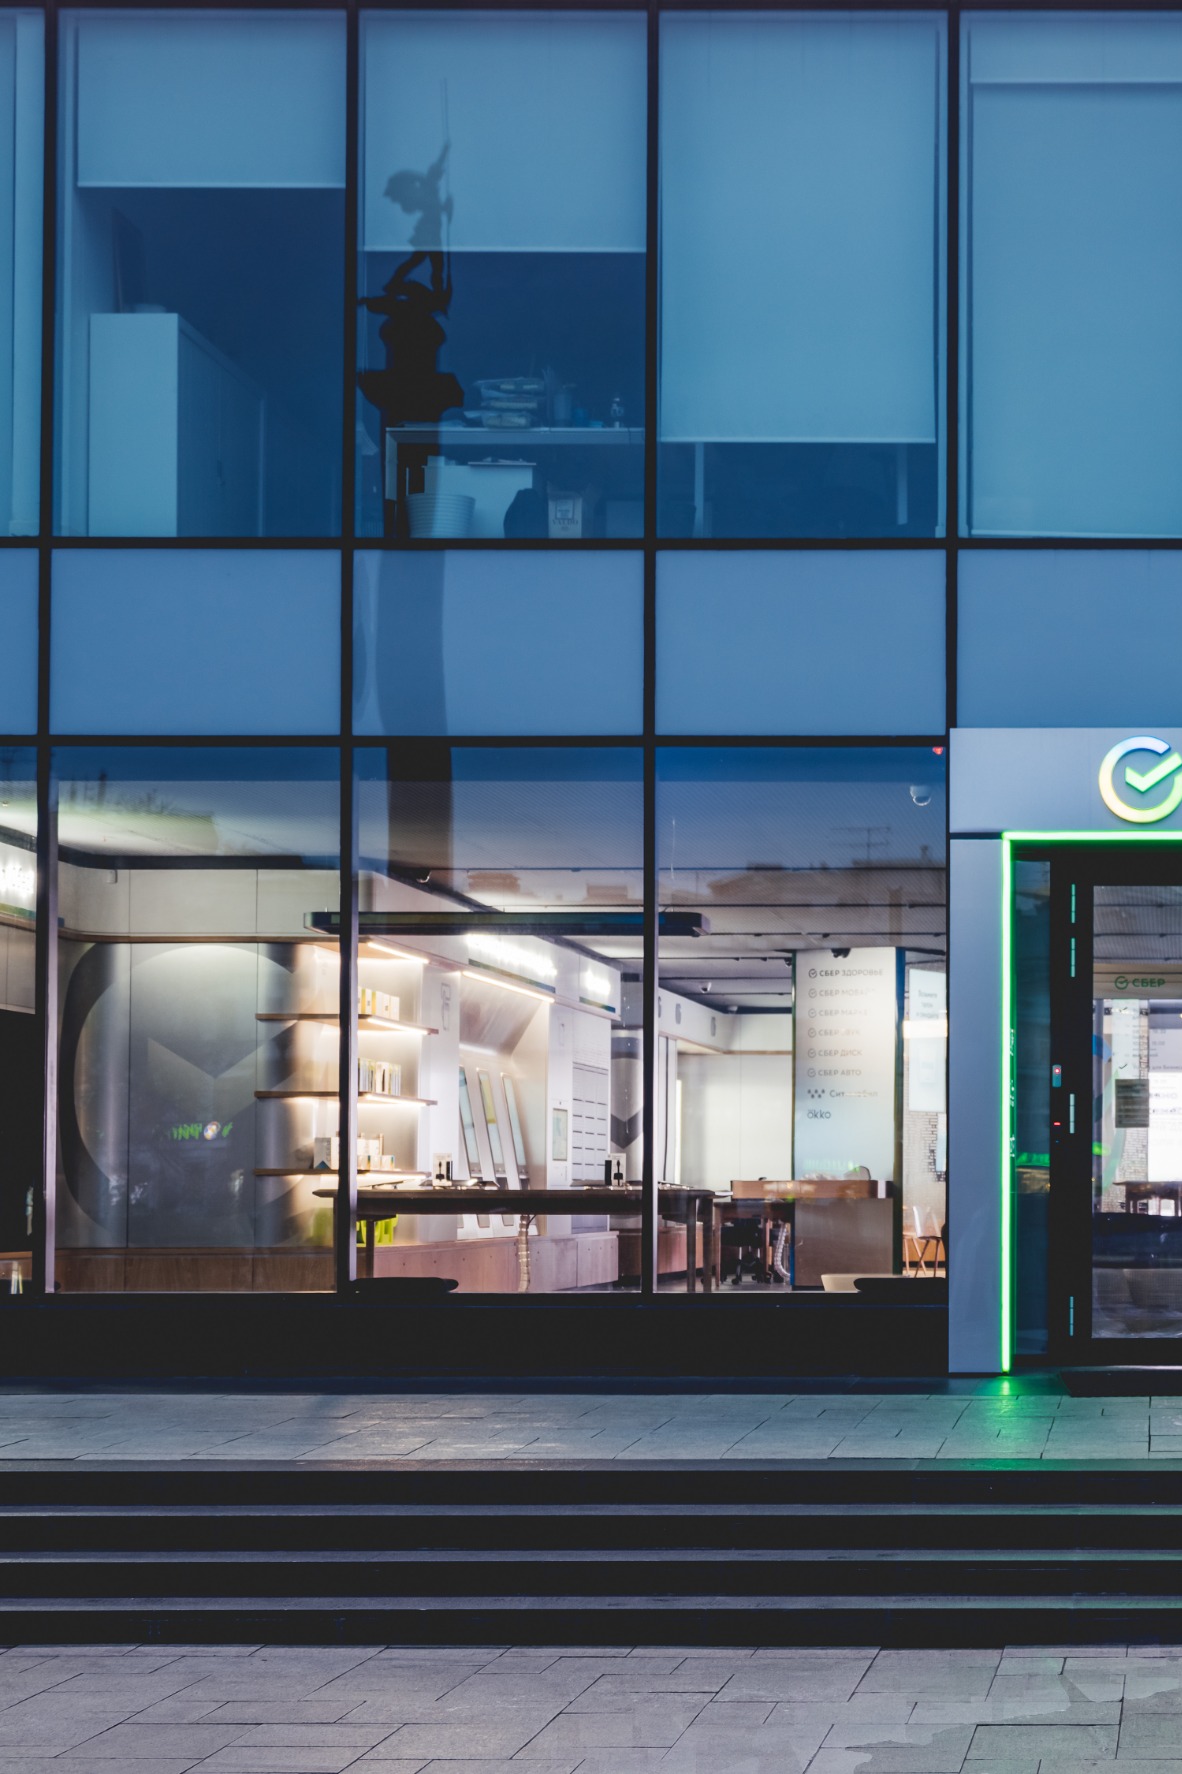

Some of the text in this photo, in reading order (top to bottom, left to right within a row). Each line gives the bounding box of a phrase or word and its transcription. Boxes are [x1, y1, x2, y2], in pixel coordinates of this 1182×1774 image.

[819, 969, 840, 977] СБЕР
[1131, 978, 1166, 988] СБЕР
[817, 1049, 864, 1057] СБЕР ДИСК
[817, 1068, 862, 1077] СБЕР АВТО
